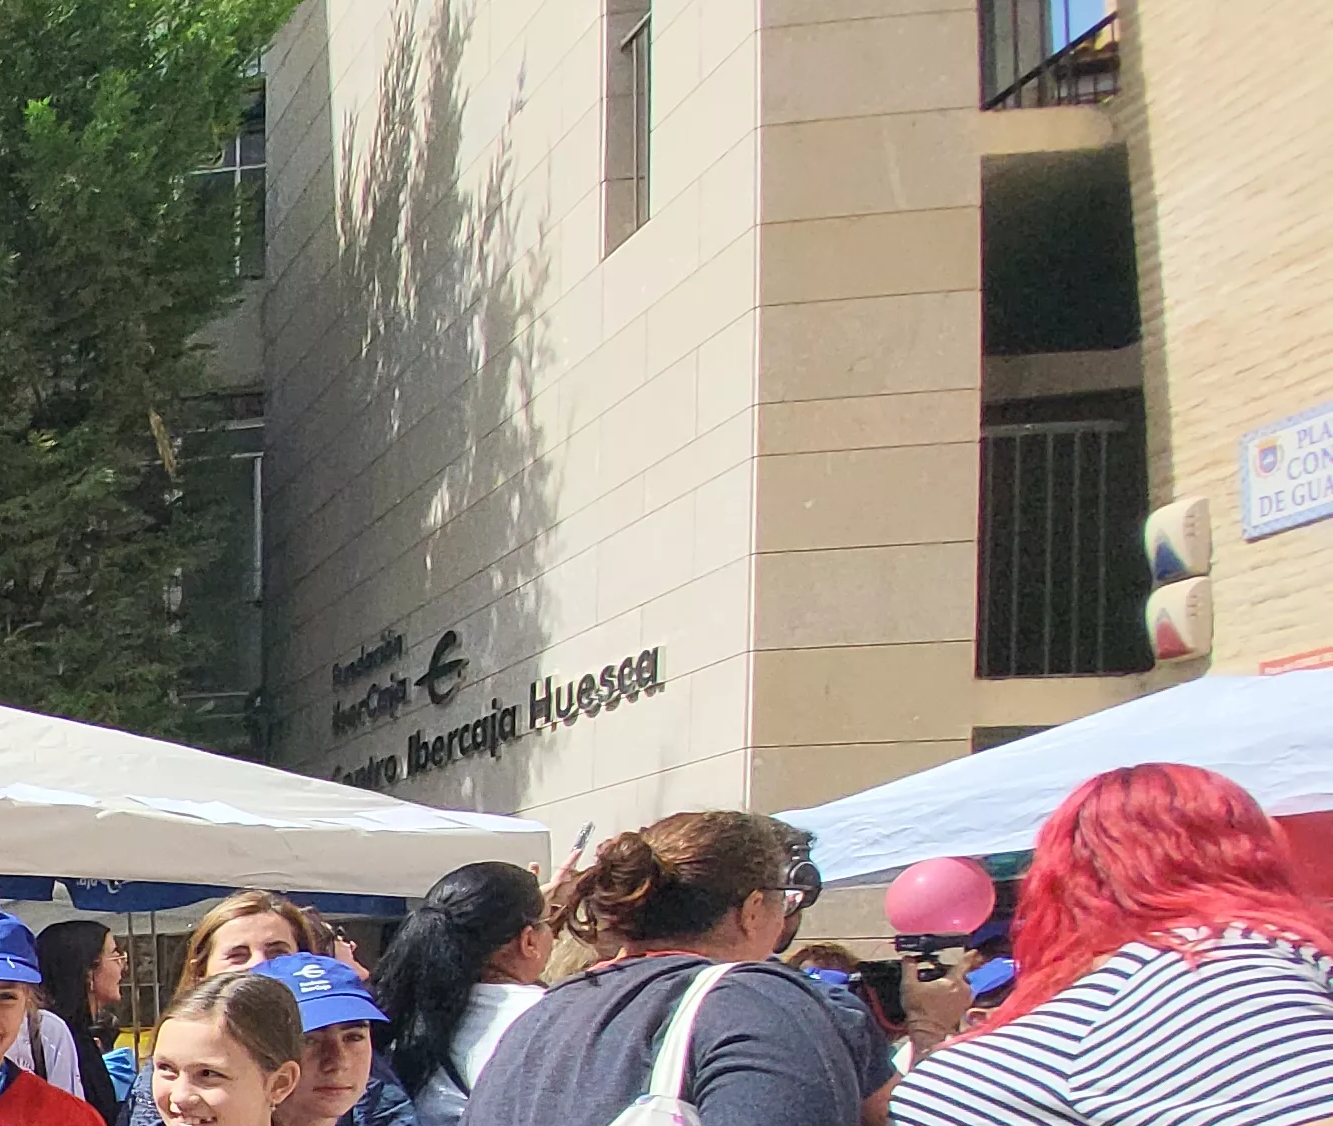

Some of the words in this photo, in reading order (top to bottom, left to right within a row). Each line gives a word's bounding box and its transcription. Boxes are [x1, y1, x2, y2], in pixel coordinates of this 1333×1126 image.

[1259, 489, 1286, 518] DE
[407, 698, 517, 776] Ibercaja
[529, 646, 660, 730] Huesca
